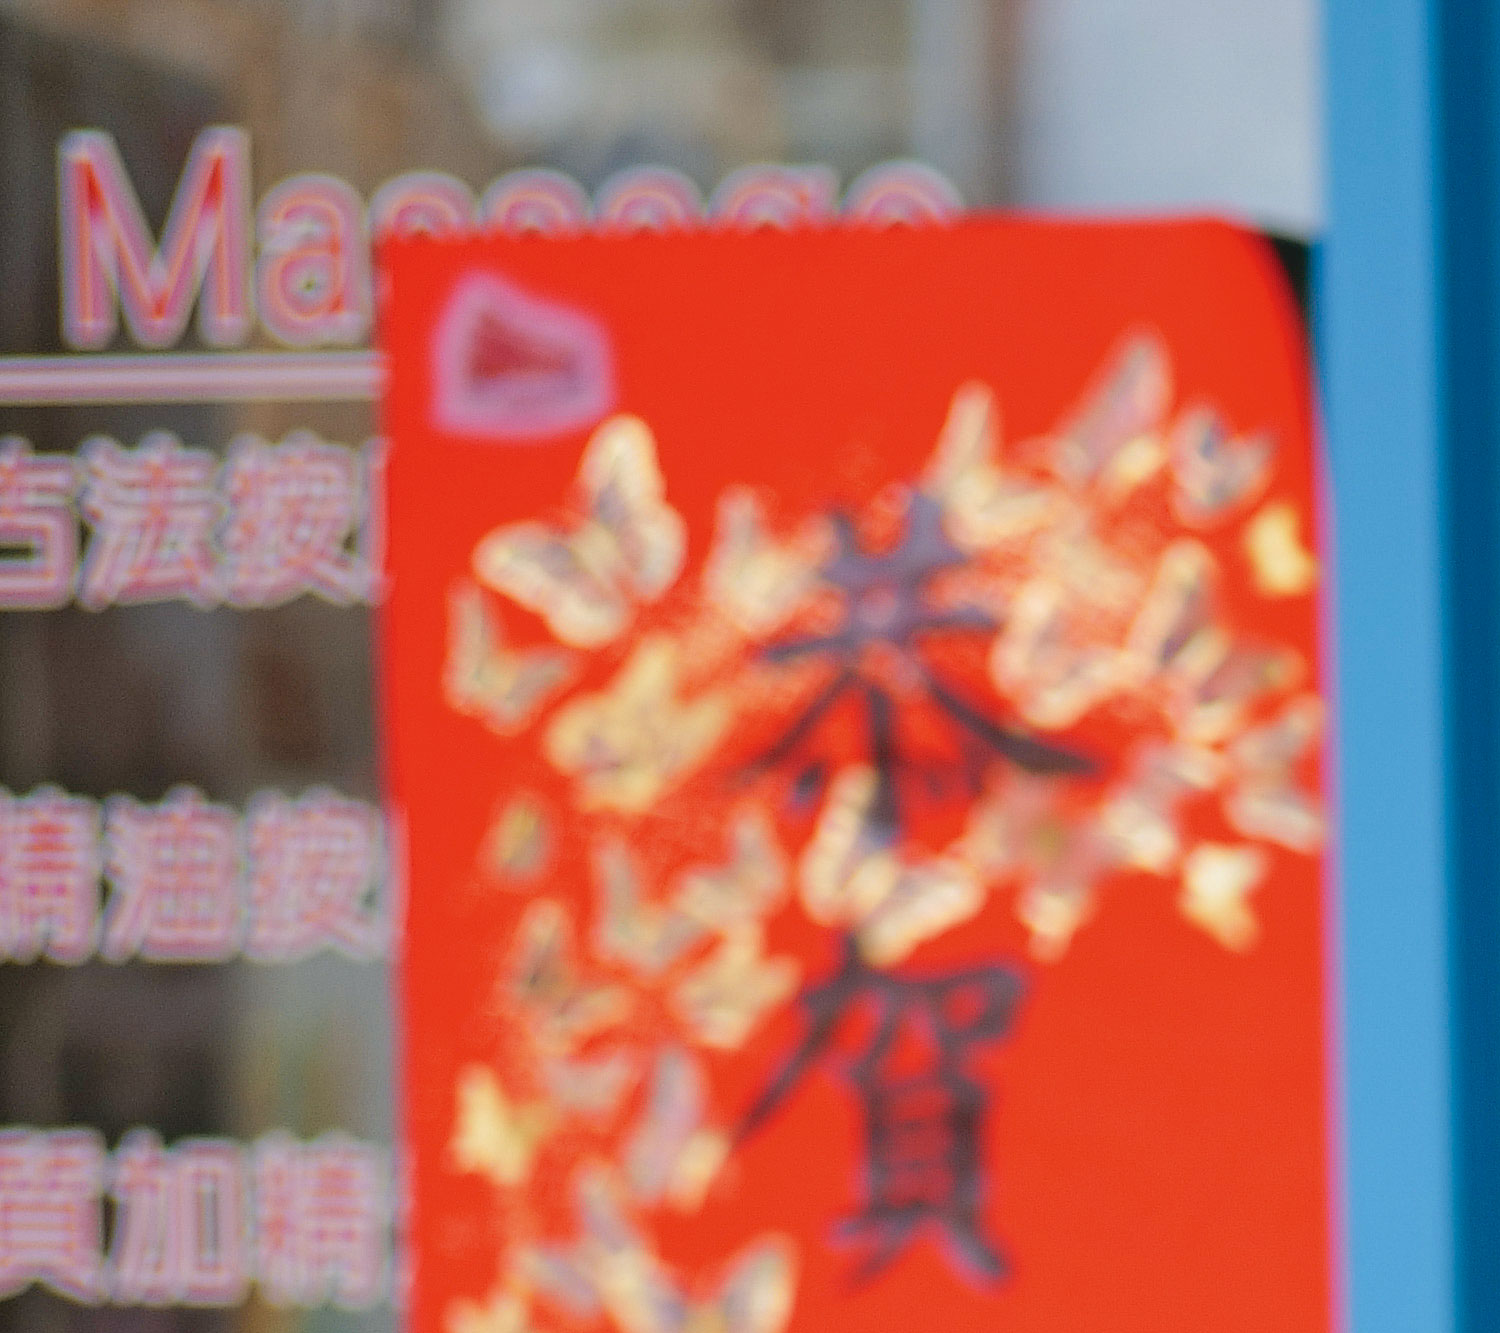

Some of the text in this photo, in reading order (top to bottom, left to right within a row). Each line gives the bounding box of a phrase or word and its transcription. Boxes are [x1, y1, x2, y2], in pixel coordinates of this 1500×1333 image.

[0, 434, 388, 610] 古法按
[0, 785, 404, 965] 精油按
